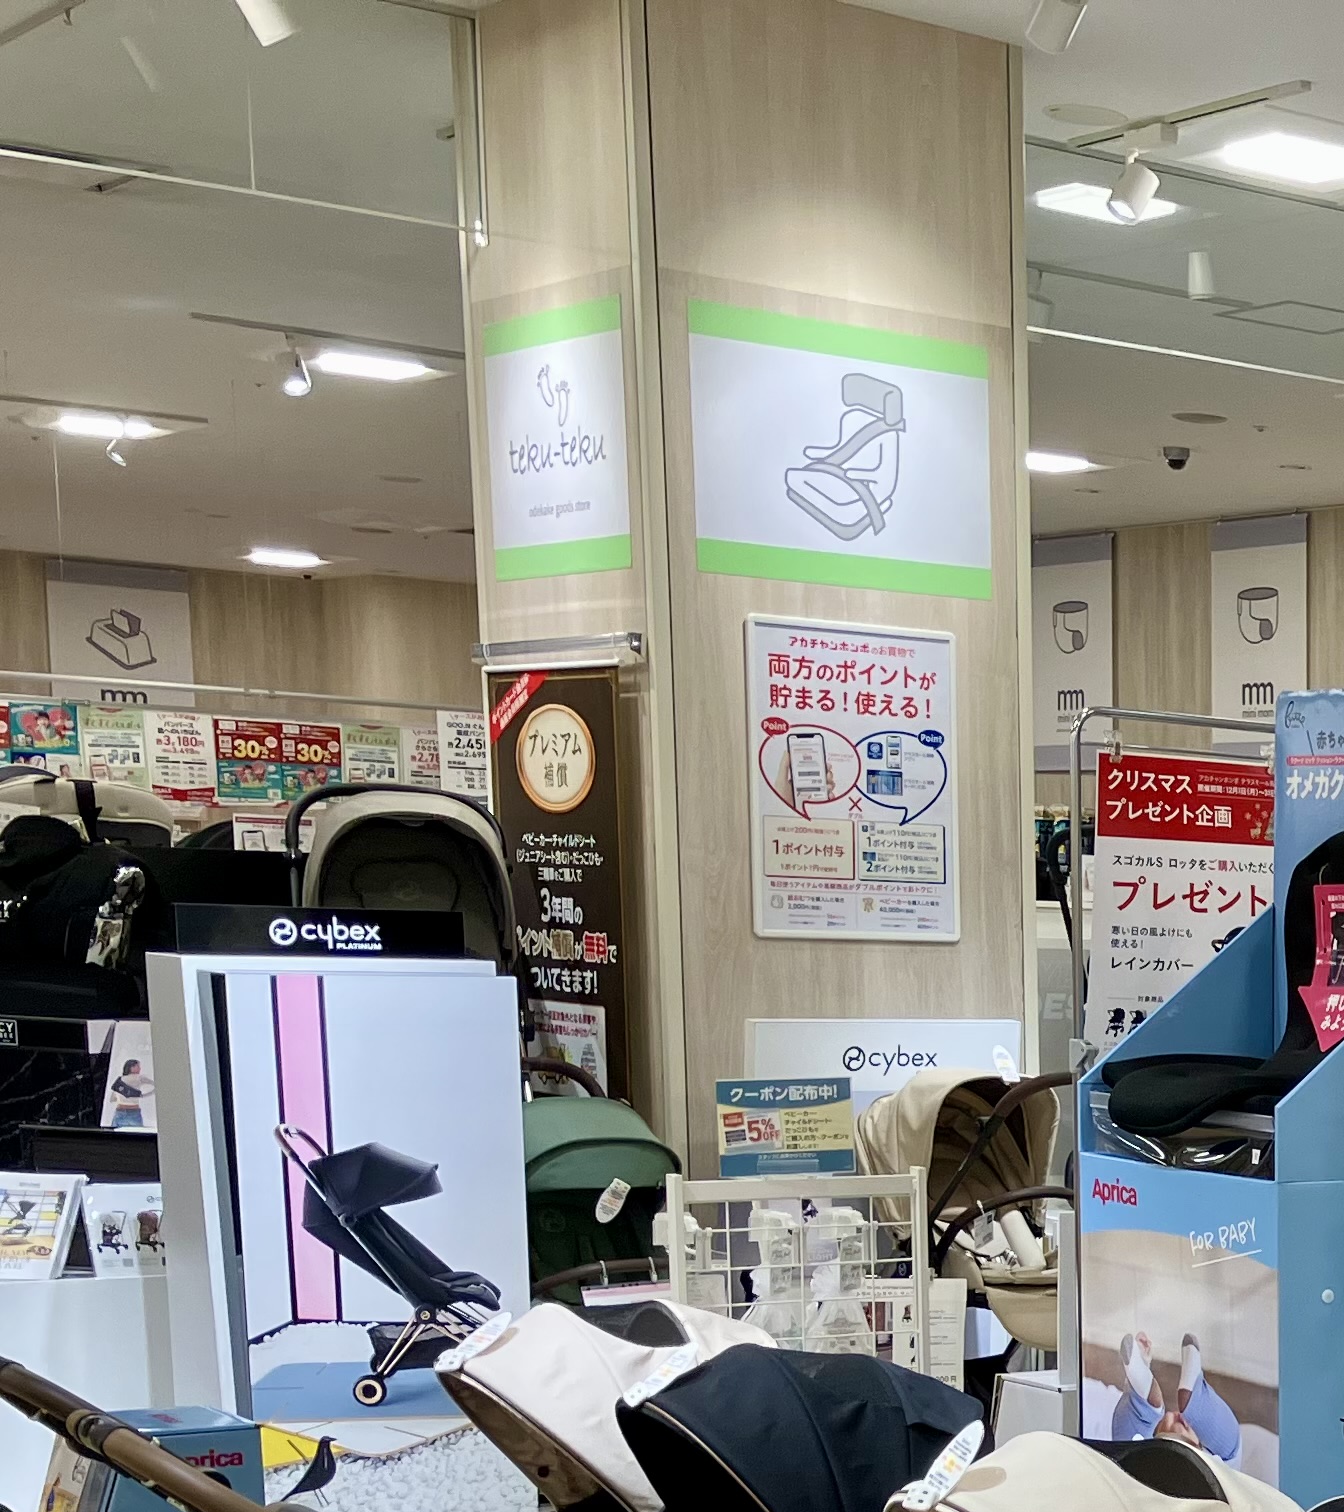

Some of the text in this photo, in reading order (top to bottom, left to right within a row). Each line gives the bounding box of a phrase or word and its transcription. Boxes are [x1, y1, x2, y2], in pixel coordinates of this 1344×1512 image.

[509, 425, 606, 475] teku-teku
[767, 652, 938, 691] 両方のポイントが
[762, 719, 789, 732] Point
[919, 732, 943, 745] Point
[528, 729, 583, 759] プレミアム
[1107, 767, 1194, 795] クリスマス
[1105, 797, 1233, 829] プレゼント企画
[772, 839, 846, 858] 1ポイント付与
[1112, 854, 1164, 868] スゴカルS
[540, 887, 584, 926] 3年間の
[1112, 875, 1268, 917] プレゼント
[300, 915, 382, 951] cybex
[335, 941, 382, 952] PLATINUM
[1111, 925, 1193, 939] 寒い日の風よけにも
[1110, 956, 1195, 972] レインカバー
[868, 1044, 938, 1077] cybex
[1092, 1178, 1138, 1207] Aprica
[1189, 1216, 1257, 1257] FOR BABY
